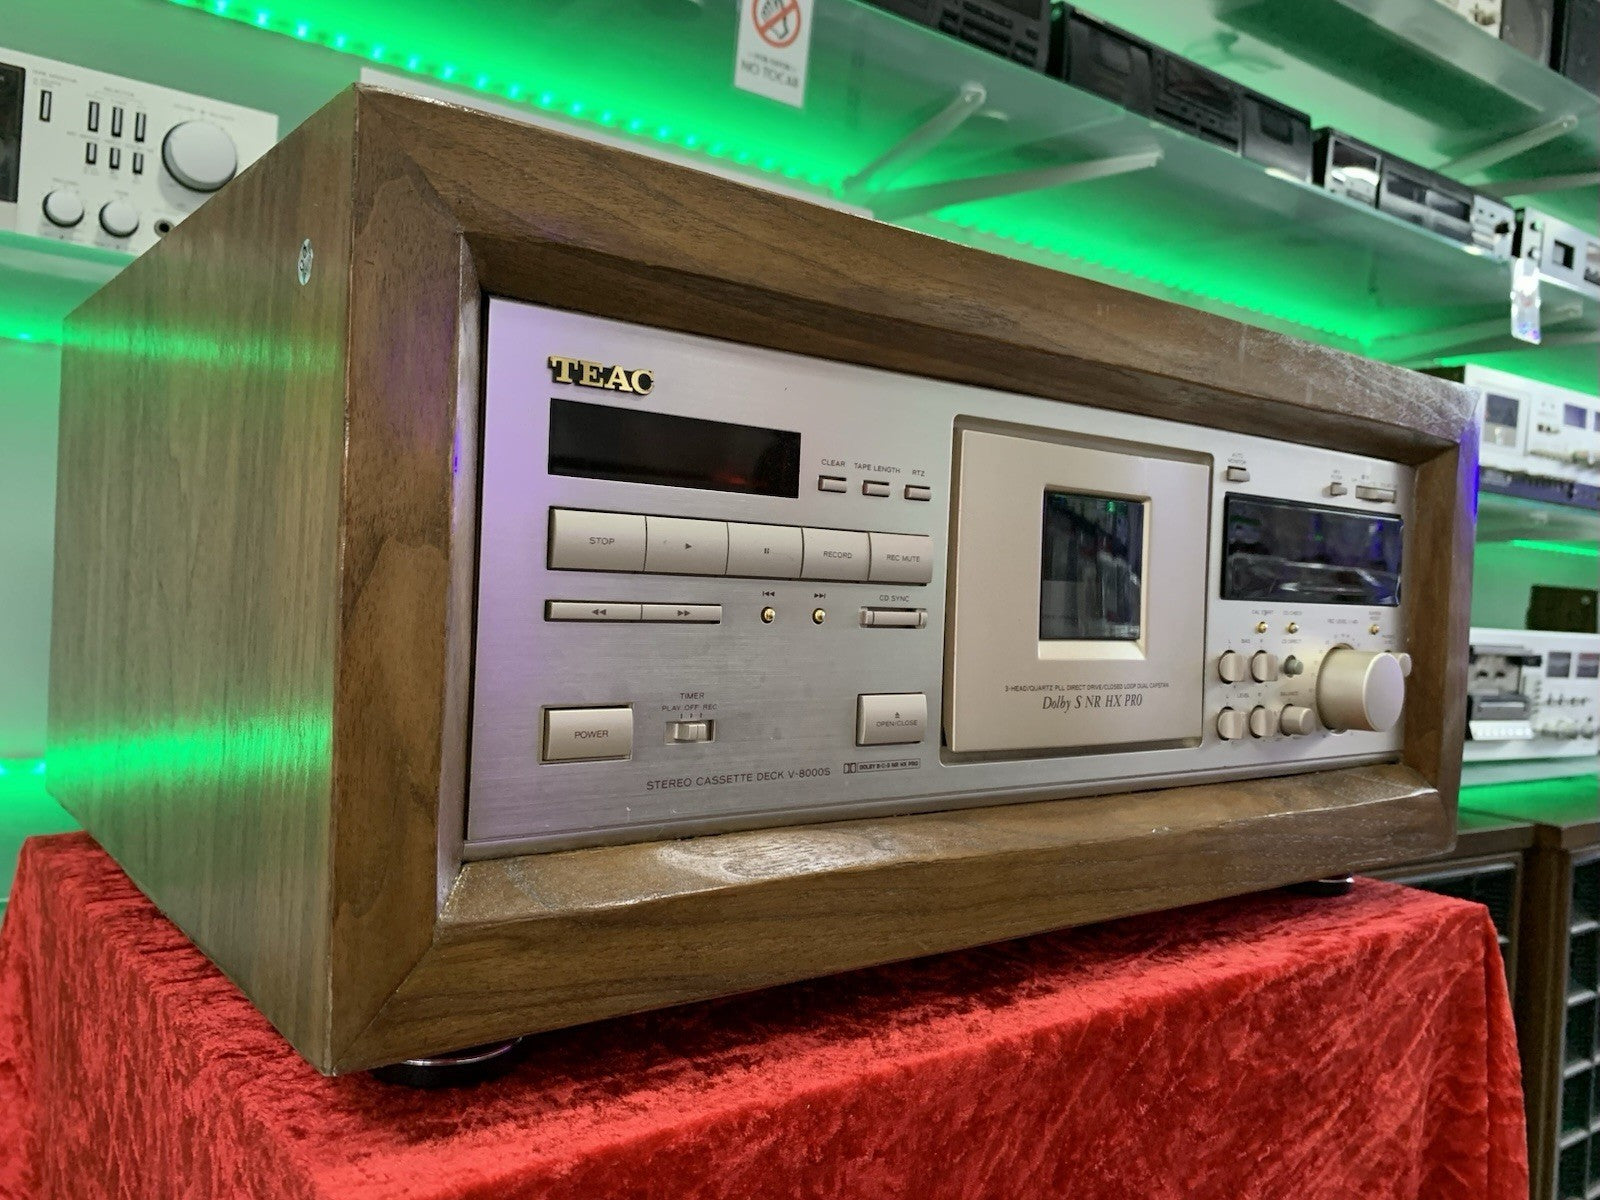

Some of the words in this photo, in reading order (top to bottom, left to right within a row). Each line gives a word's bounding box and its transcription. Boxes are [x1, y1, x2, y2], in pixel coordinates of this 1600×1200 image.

[548, 355, 655, 395] TEAC
[821, 459, 846, 467] CLEAR
[854, 462, 872, 471] TAPE
[873, 465, 900, 474] LENGTH
[912, 469, 925, 477] RTZ
[589, 536, 615, 546] STOP
[823, 550, 852, 559] RECORD
[886, 554, 901, 562] REC
[902, 555, 920, 563] MUTE
[879, 594, 890, 602] CD
[680, 692, 705, 700] TIMER
[1042, 695, 1071, 713] Dolby
[1074, 695, 1083, 709] S
[1085, 695, 1102, 709] NR
[1105, 694, 1122, 708] HX
[1124, 693, 1143, 707] PRO
[574, 730, 609, 739] POWER
[646, 777, 692, 791] STEREO
[695, 773, 753, 786] CASSETTE
[756, 770, 784, 782] DECK
[788, 767, 831, 779] V-8000S
